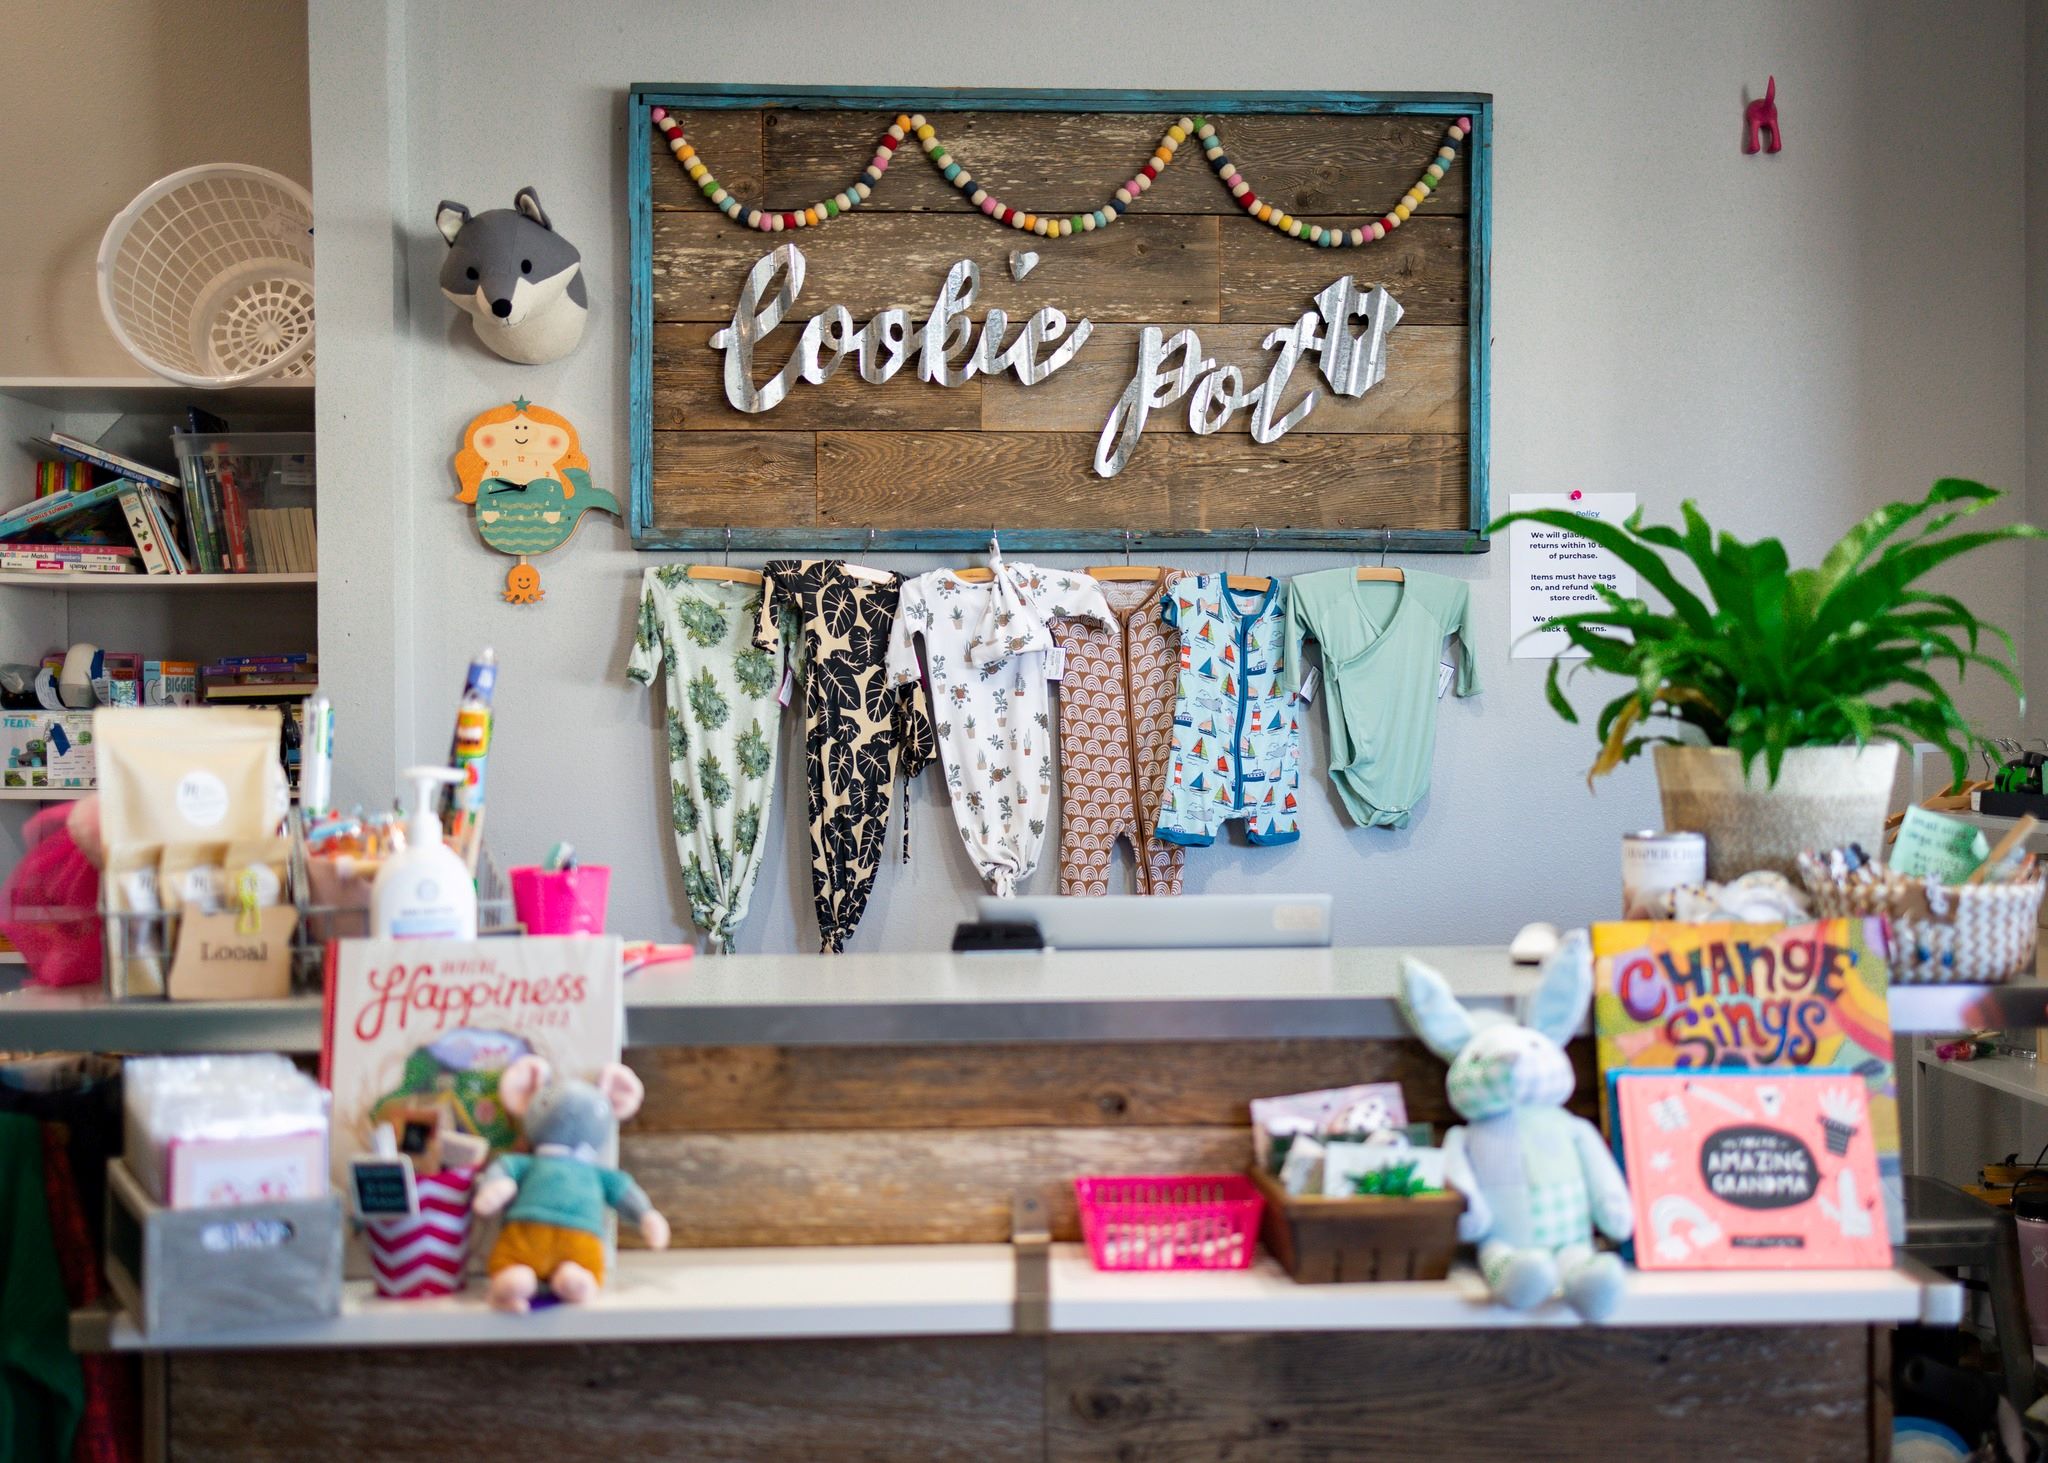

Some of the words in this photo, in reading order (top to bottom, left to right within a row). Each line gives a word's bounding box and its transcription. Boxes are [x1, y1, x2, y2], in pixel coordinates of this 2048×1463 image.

[709, 242, 1094, 413] Cookie
[1093, 311, 1321, 478] pot
[1576, 510, 1600, 518] Policy
[201, 943, 268, 961] Local
[354, 963, 588, 1042] Happiness
[1708, 1150, 1808, 1172] AMAZING
[1711, 1172, 1809, 1196] GRANDMA
